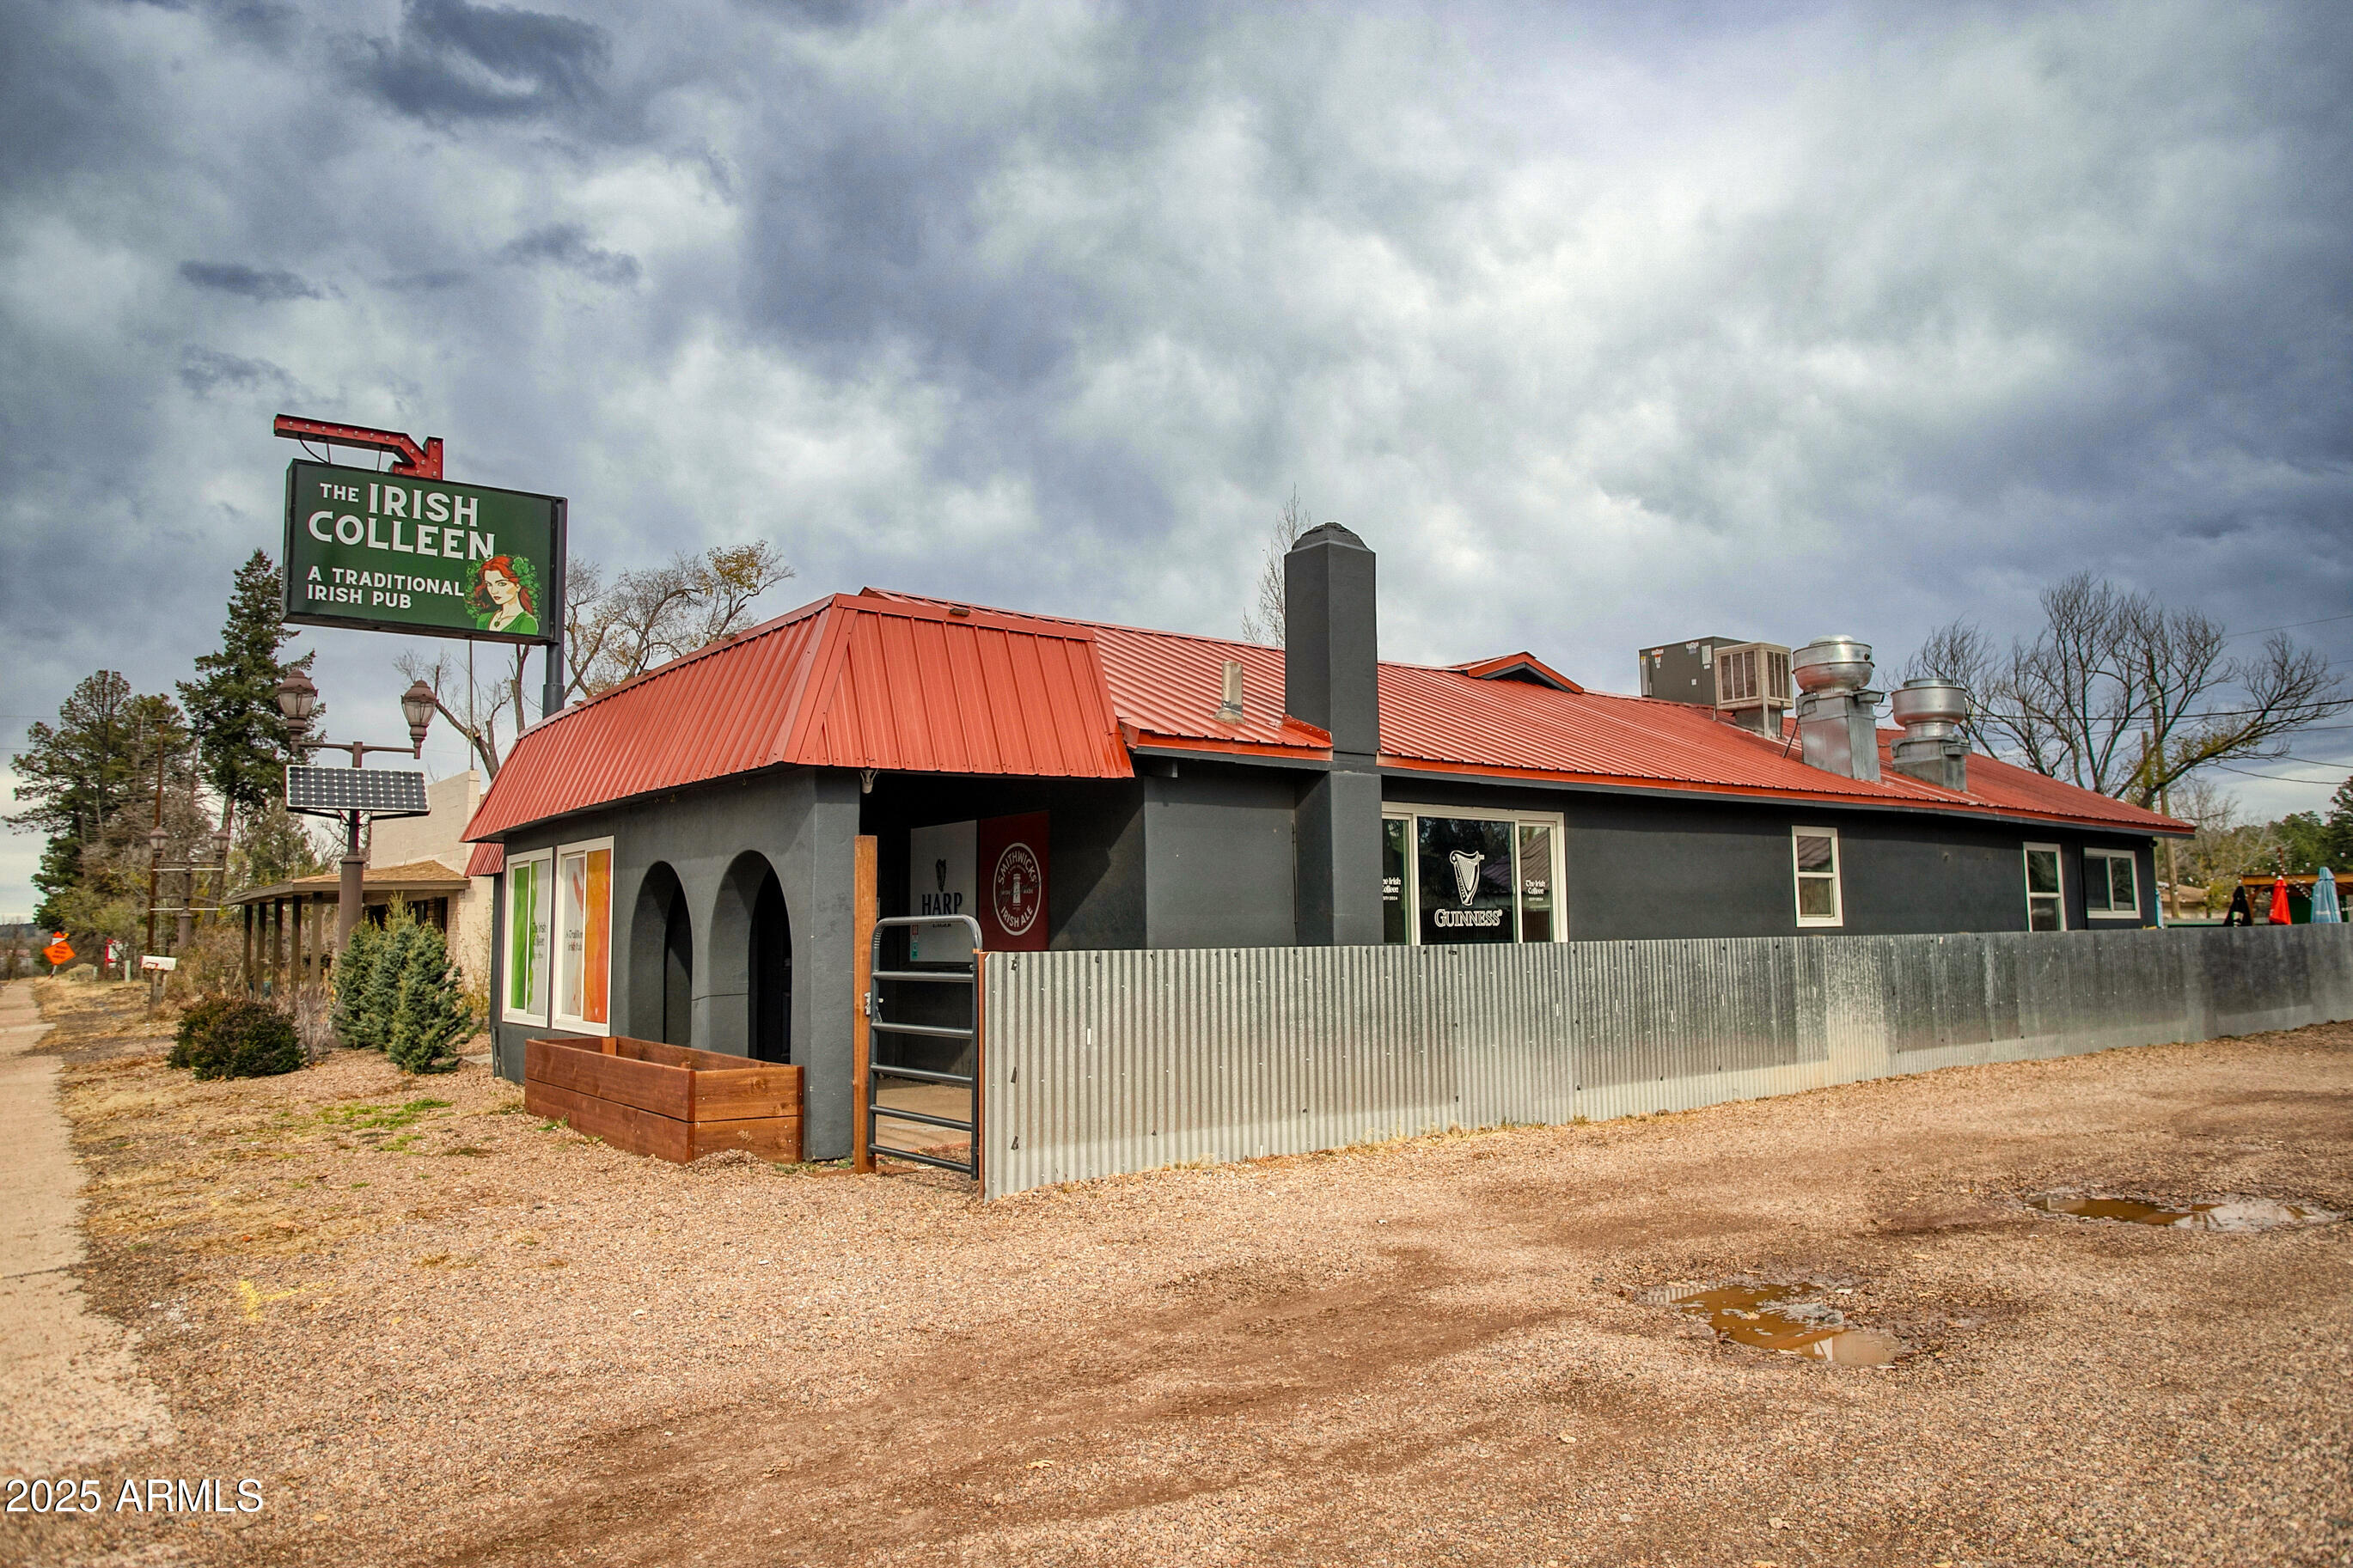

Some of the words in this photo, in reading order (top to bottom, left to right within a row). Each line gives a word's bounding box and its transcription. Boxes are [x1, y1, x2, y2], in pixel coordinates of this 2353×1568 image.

[320, 482, 359, 503] THE
[368, 482, 479, 528] IRISH
[308, 510, 495, 561] COLLEEN
[307, 565, 321, 582] A
[332, 567, 465, 597] TRADITIONAL
[307, 583, 363, 604] IRISH
[372, 590, 412, 609] PUB
[921, 892, 963, 916] HARP
[1000, 906, 1019, 928] IRISH
[1020, 904, 1033, 925] ALE
[1434, 908, 1501, 927] GUINNESS
